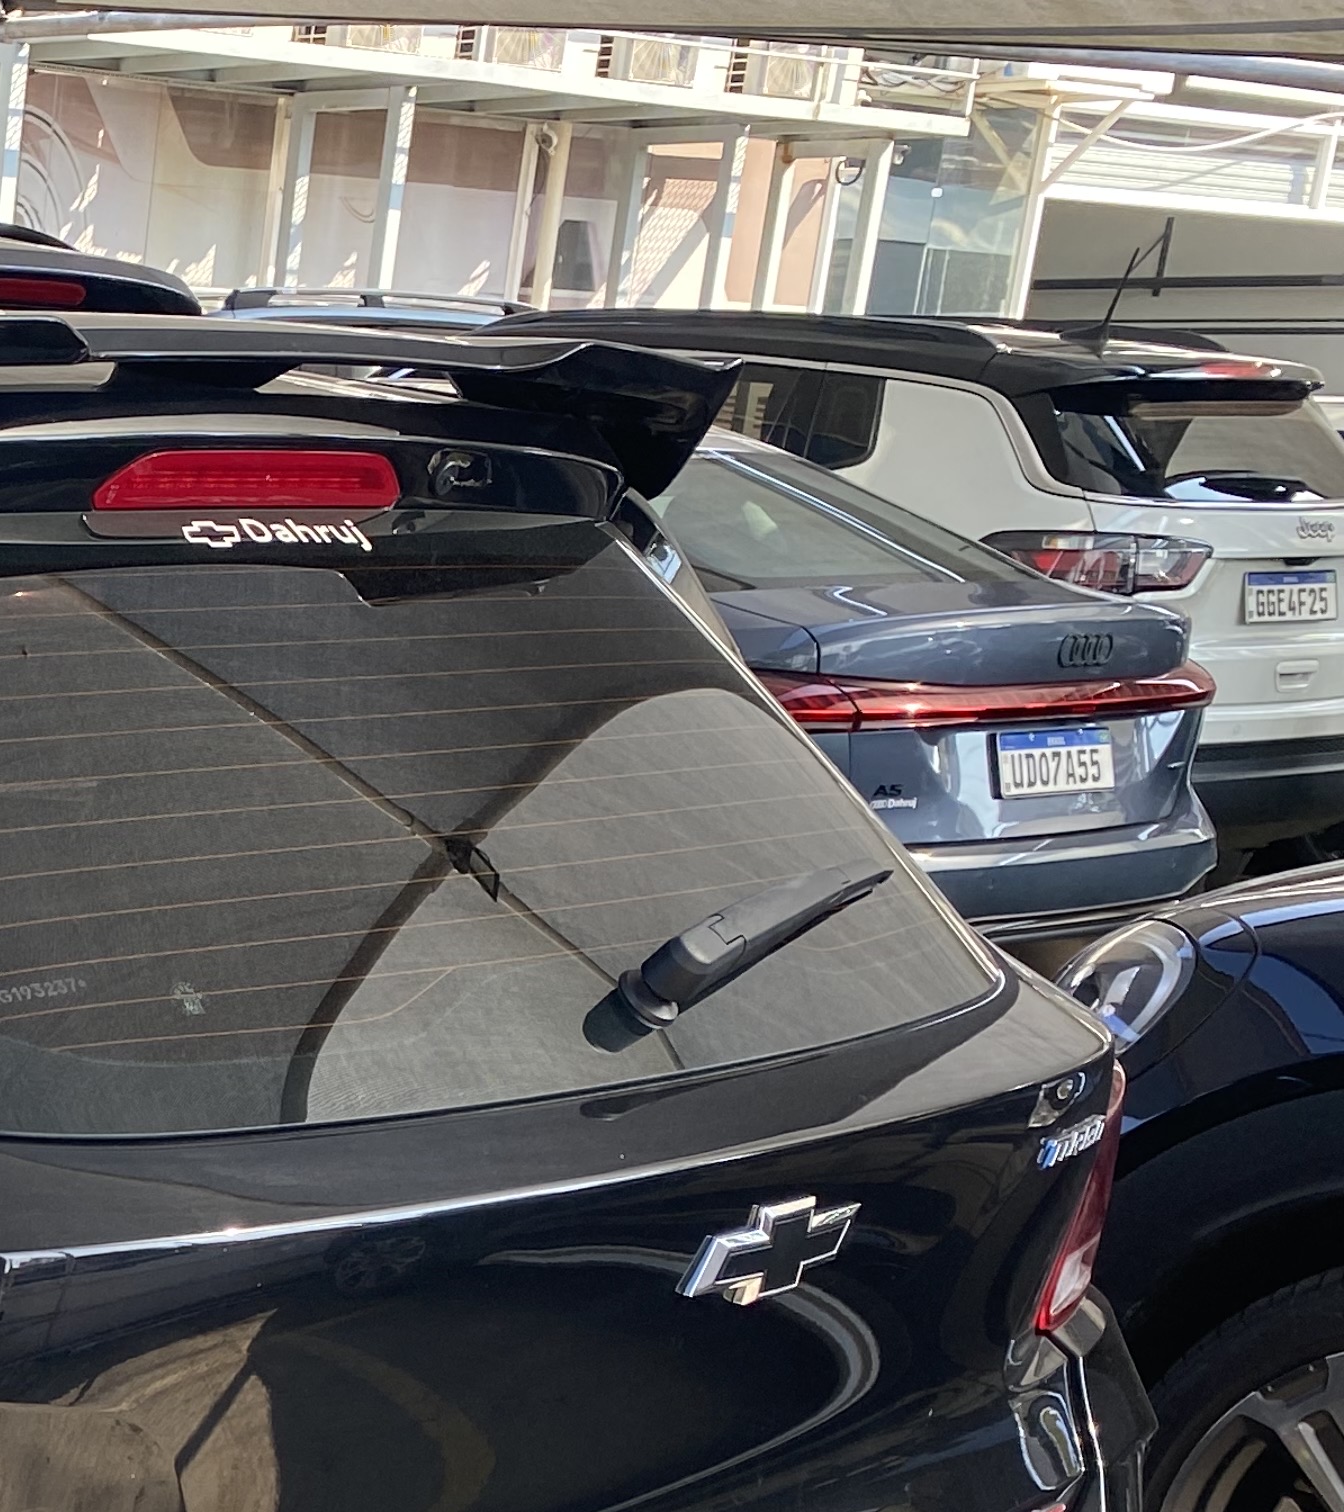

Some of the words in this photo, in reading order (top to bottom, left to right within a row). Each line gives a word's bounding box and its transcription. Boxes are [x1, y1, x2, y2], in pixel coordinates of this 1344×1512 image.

[243, 514, 373, 552] Dahruj
[1255, 587, 1328, 617] GGE4F25
[873, 784, 904, 797] A5
